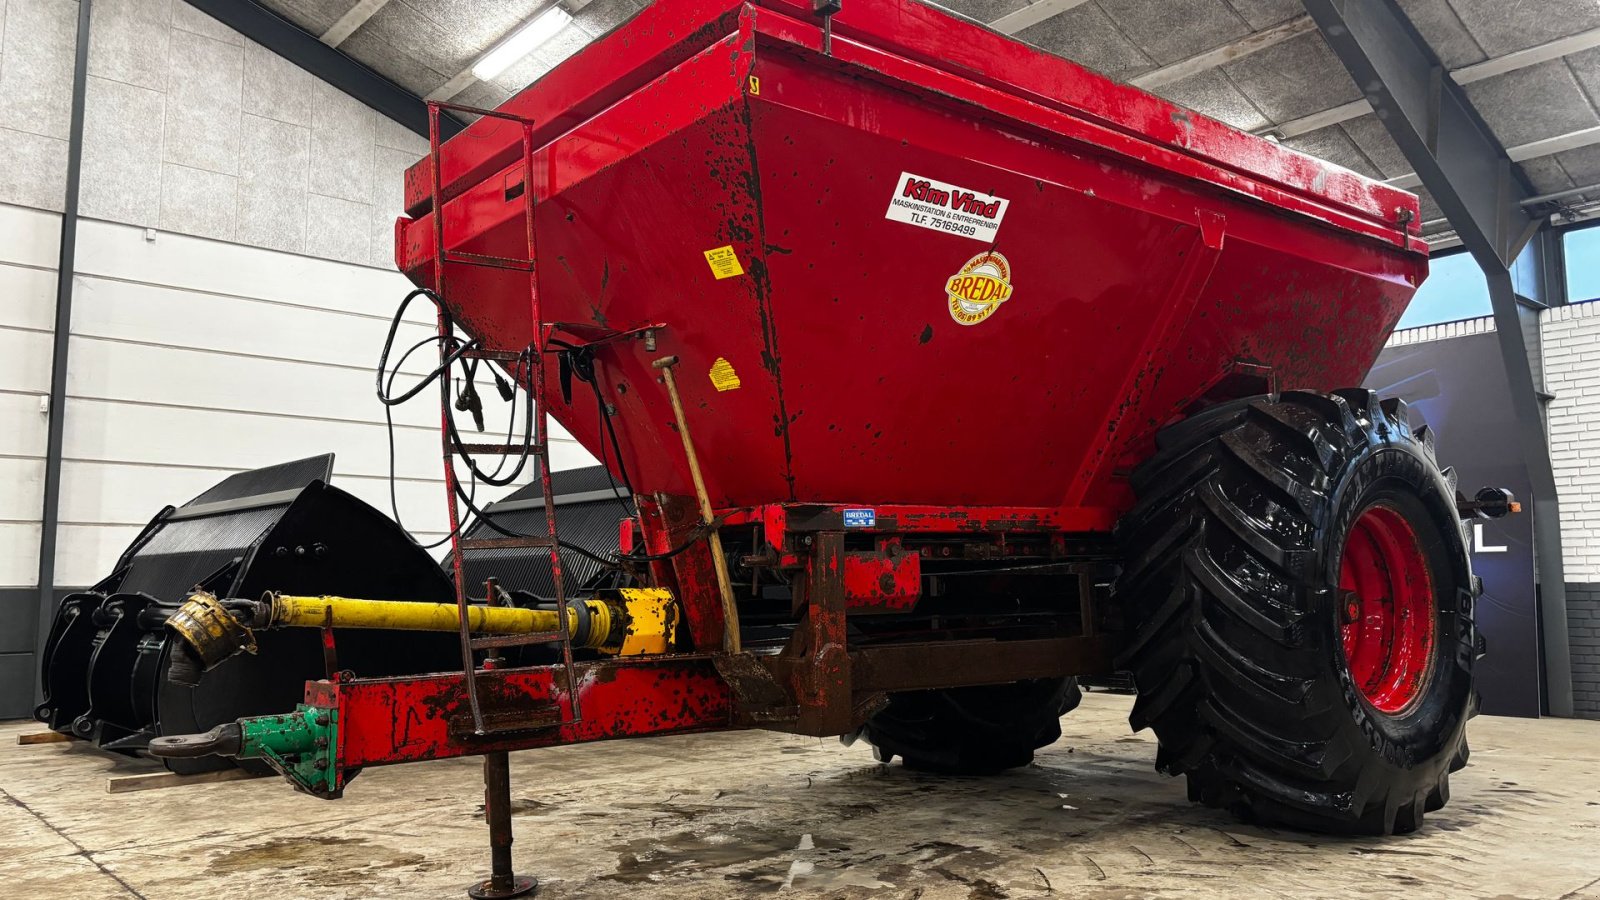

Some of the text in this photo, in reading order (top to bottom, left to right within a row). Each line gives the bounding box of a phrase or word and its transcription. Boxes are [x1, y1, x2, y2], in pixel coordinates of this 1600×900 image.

[892, 198, 946, 217] MASKINSTATION
[903, 178, 1001, 219] Kim Vind
[910, 212, 976, 236] TLF. 75169499
[950, 276, 1009, 301] BREDAL
[1456, 587, 1474, 671] BKT
